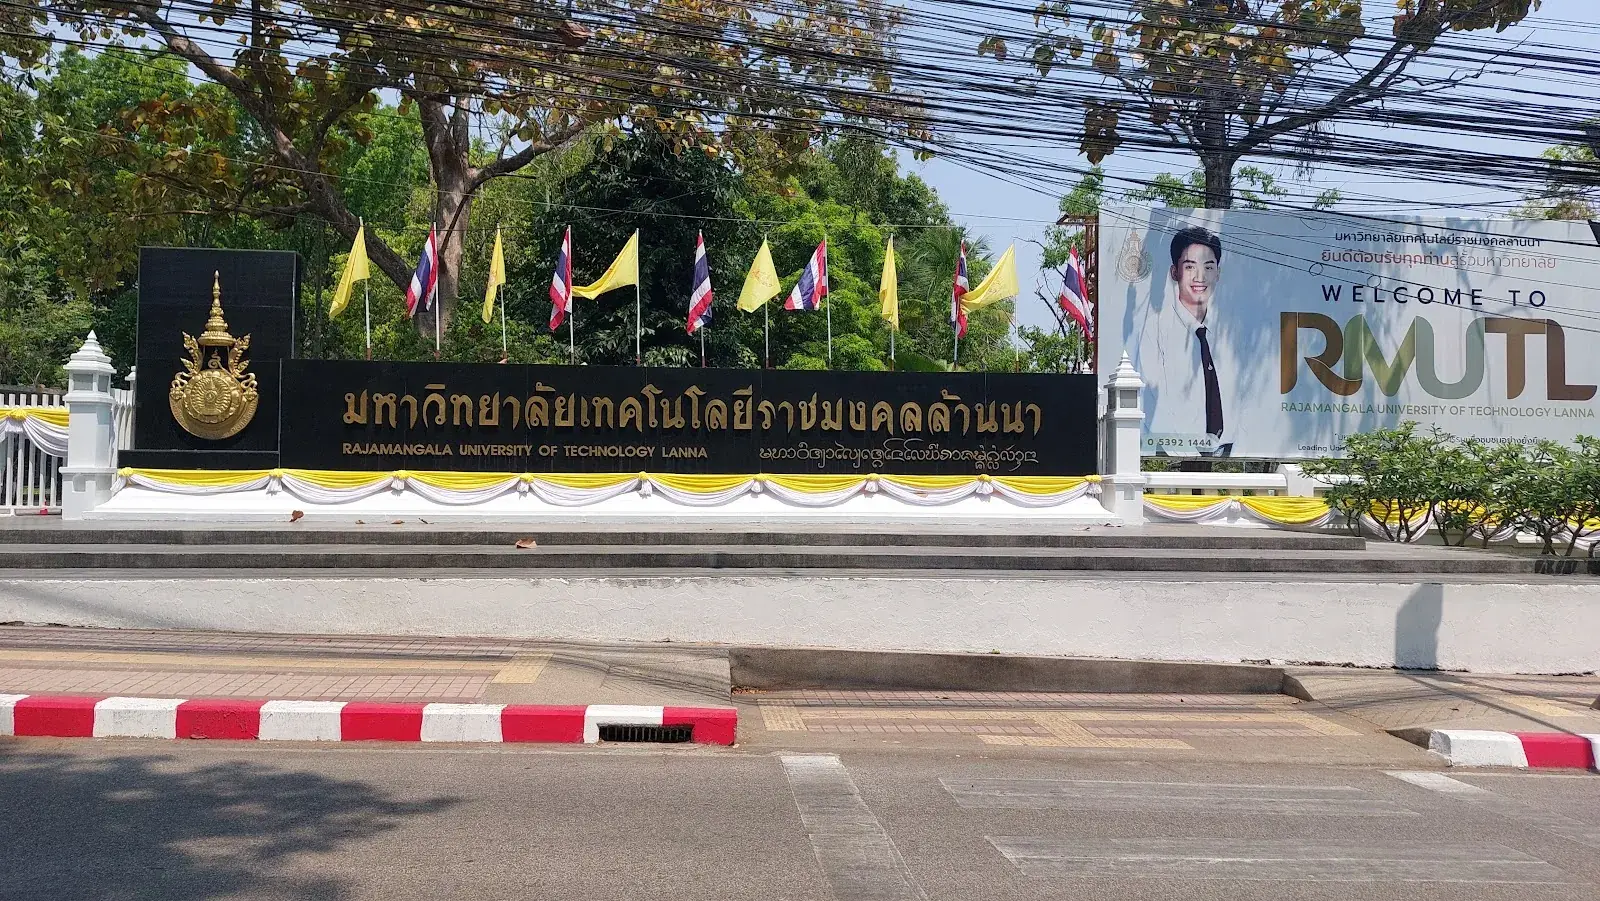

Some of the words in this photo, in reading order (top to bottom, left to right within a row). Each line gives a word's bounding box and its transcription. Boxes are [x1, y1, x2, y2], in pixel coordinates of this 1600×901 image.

[1334, 230, 1541, 247] มหาวิทยาลัยเทคโนโลยีราชมงคลลานนา
[1321, 284, 1483, 305] WELCOME
[1508, 289, 1546, 308] TO
[1280, 311, 1597, 401] RMUTL
[343, 382, 1041, 435] มหาวิทยาลัยเทคโนโลยีราชมงคลล้านนา
[1281, 402, 1374, 415] RAJAMANGALA
[1377, 404, 1446, 416] UNIVERSITY
[1449, 405, 1466, 416] OF
[1469, 406, 1551, 418] TECHNOLOGY
[1554, 407, 1595, 418] LANNA
[342, 442, 452, 456] RAJAMANGALA
[459, 444, 533, 457] UNIVERSITY
[538, 445, 558, 457] OF
[564, 446, 655, 458] TECHNOLOGY
[661, 447, 708, 458] LANNA
[1147, 438, 1154, 446] 0
[1158, 438, 1184, 447] 5392
[1188, 439, 1212, 447] 1444
[1297, 443, 1328, 453] Leading
